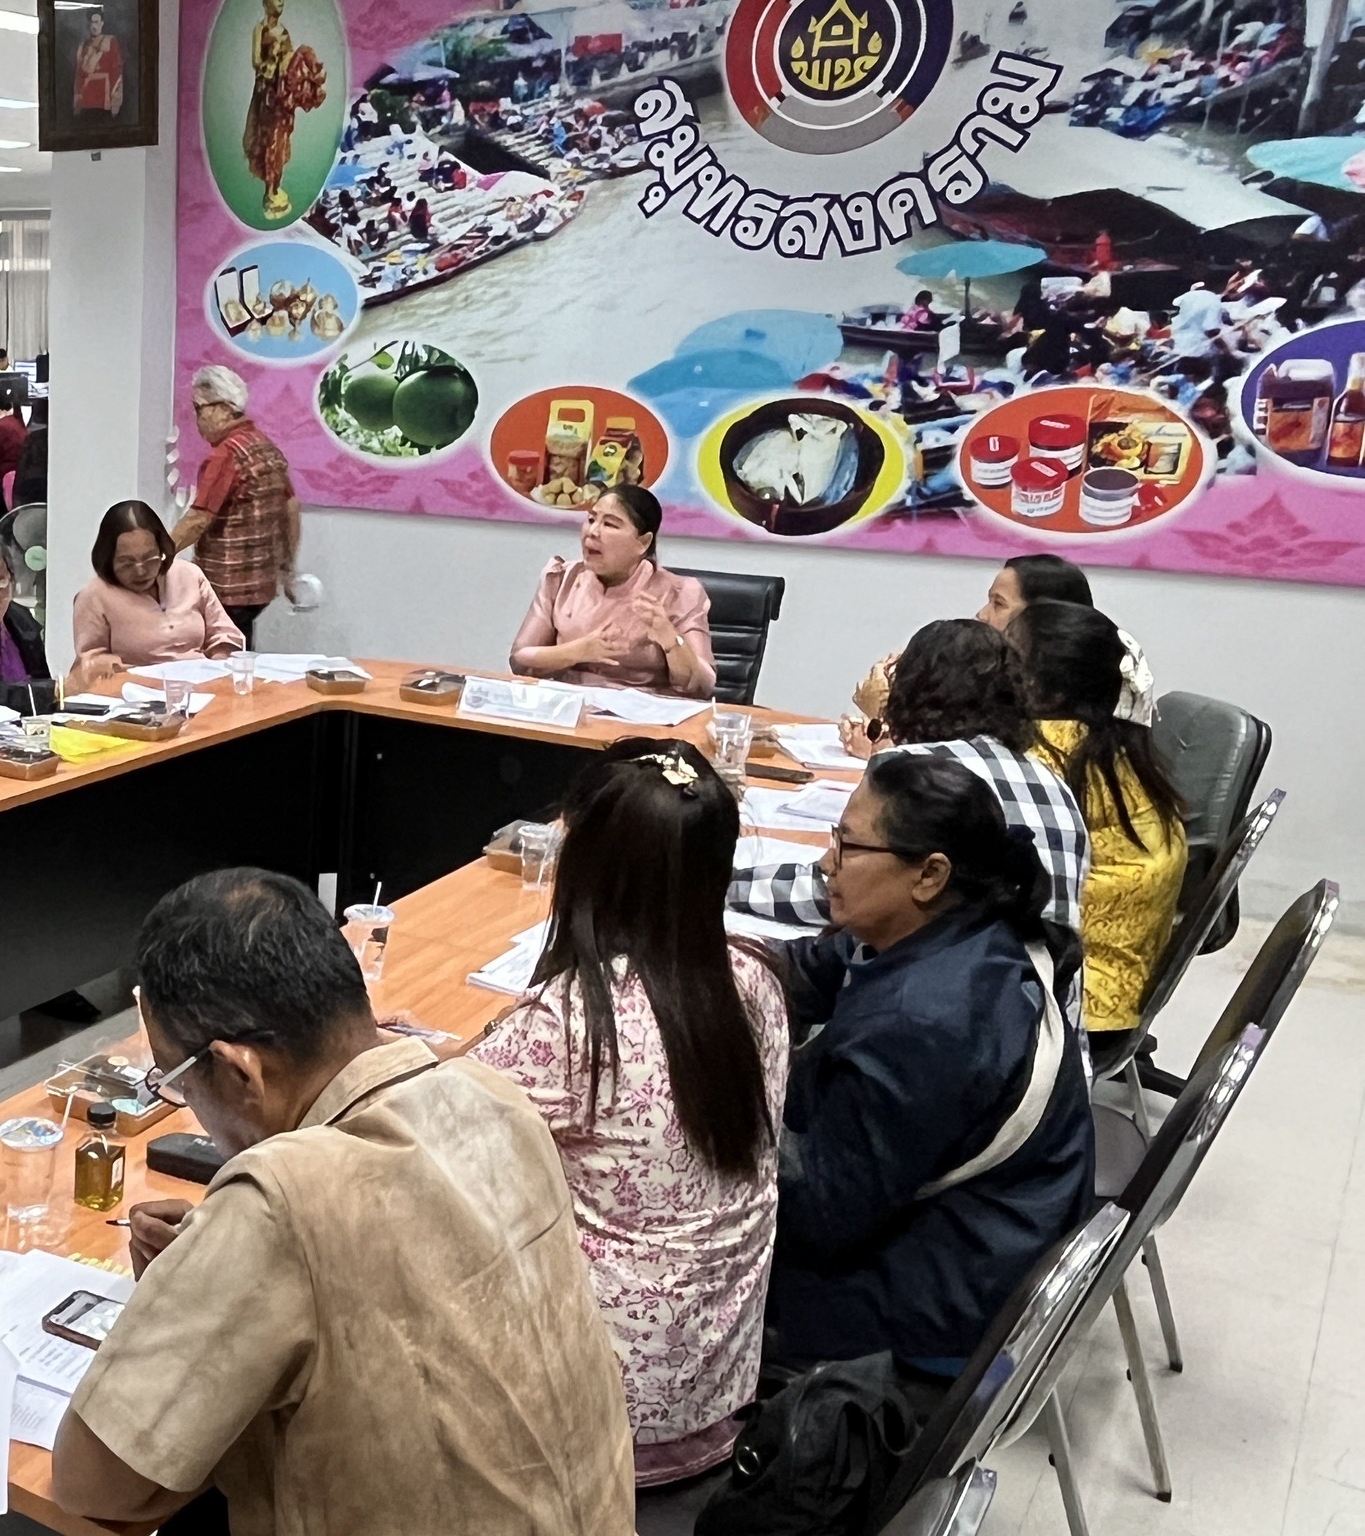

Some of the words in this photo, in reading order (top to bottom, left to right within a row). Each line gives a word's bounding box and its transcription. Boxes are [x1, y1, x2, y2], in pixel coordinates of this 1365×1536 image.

[631, 50, 1064, 260] สมุทรสงคราม
